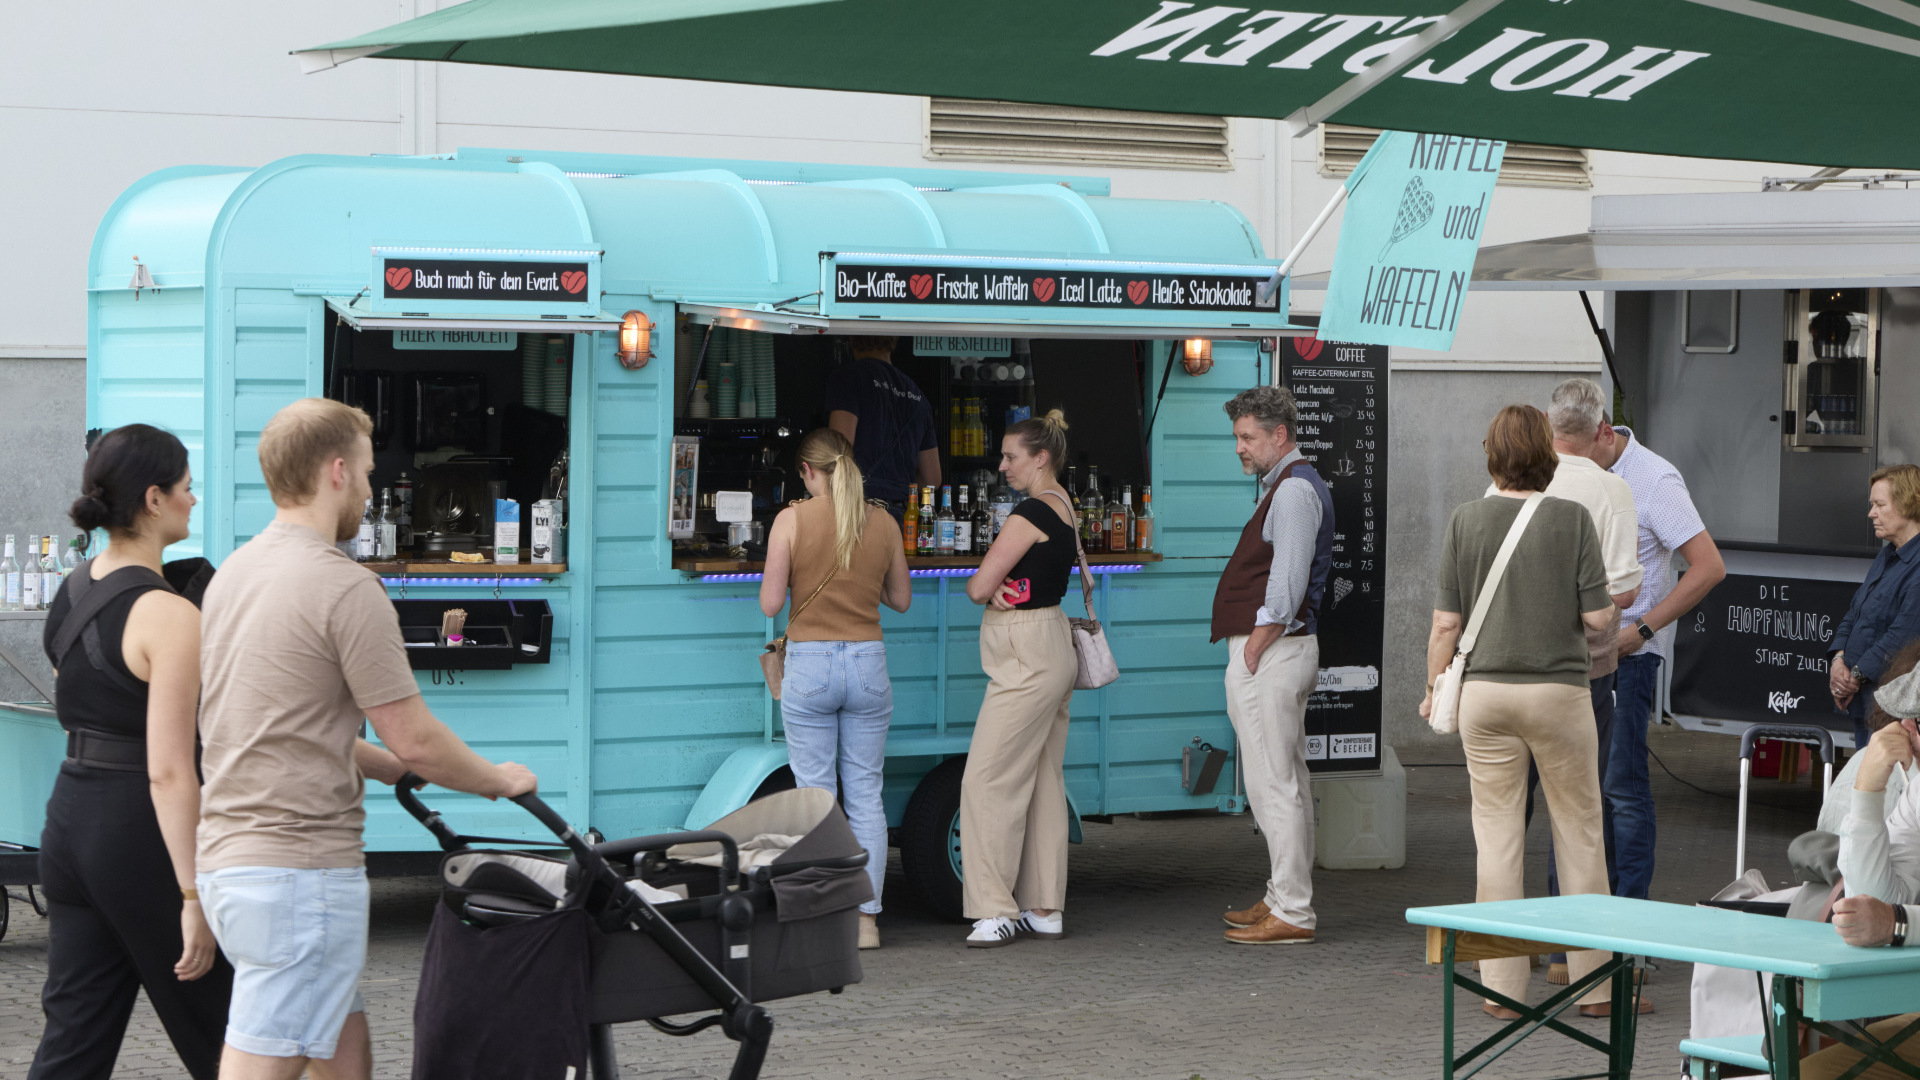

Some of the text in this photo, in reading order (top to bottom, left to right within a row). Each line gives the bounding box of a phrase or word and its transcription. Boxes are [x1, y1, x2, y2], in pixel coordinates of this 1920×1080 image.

[1443, 192, 1486, 240] und
[415, 269, 560, 292] Buch mich für dein Event
[838, 271, 1252, 306] Bio-Kaffee Frische Waffeln Iced Latte Heiße Schokolade
[1360, 266, 1466, 332] WAFFELN
[400, 330, 436, 343] HIER
[915, 336, 1008, 352] HIER BESTELLEN
[1336, 348, 1366, 362] COFFEE
[1292, 369, 1374, 378] KAFFEE-CATERING MIT STIL
[1294, 384, 1307, 394] Latte
[1310, 385, 1334, 395] Macchiato
[1295, 399, 1320, 409] appuccino
[1306, 426, 1320, 435] White
[1296, 440, 1333, 450] spresso/Doppio
[536, 517, 548, 526] LY!
[1760, 584, 1790, 601] DIE
[1728, 605, 1833, 642] HOPFNUNG
[1756, 648, 1828, 674] STIRBT ZULET
[1768, 691, 1805, 714] Käfer
[1343, 744, 1372, 753] BECHER
